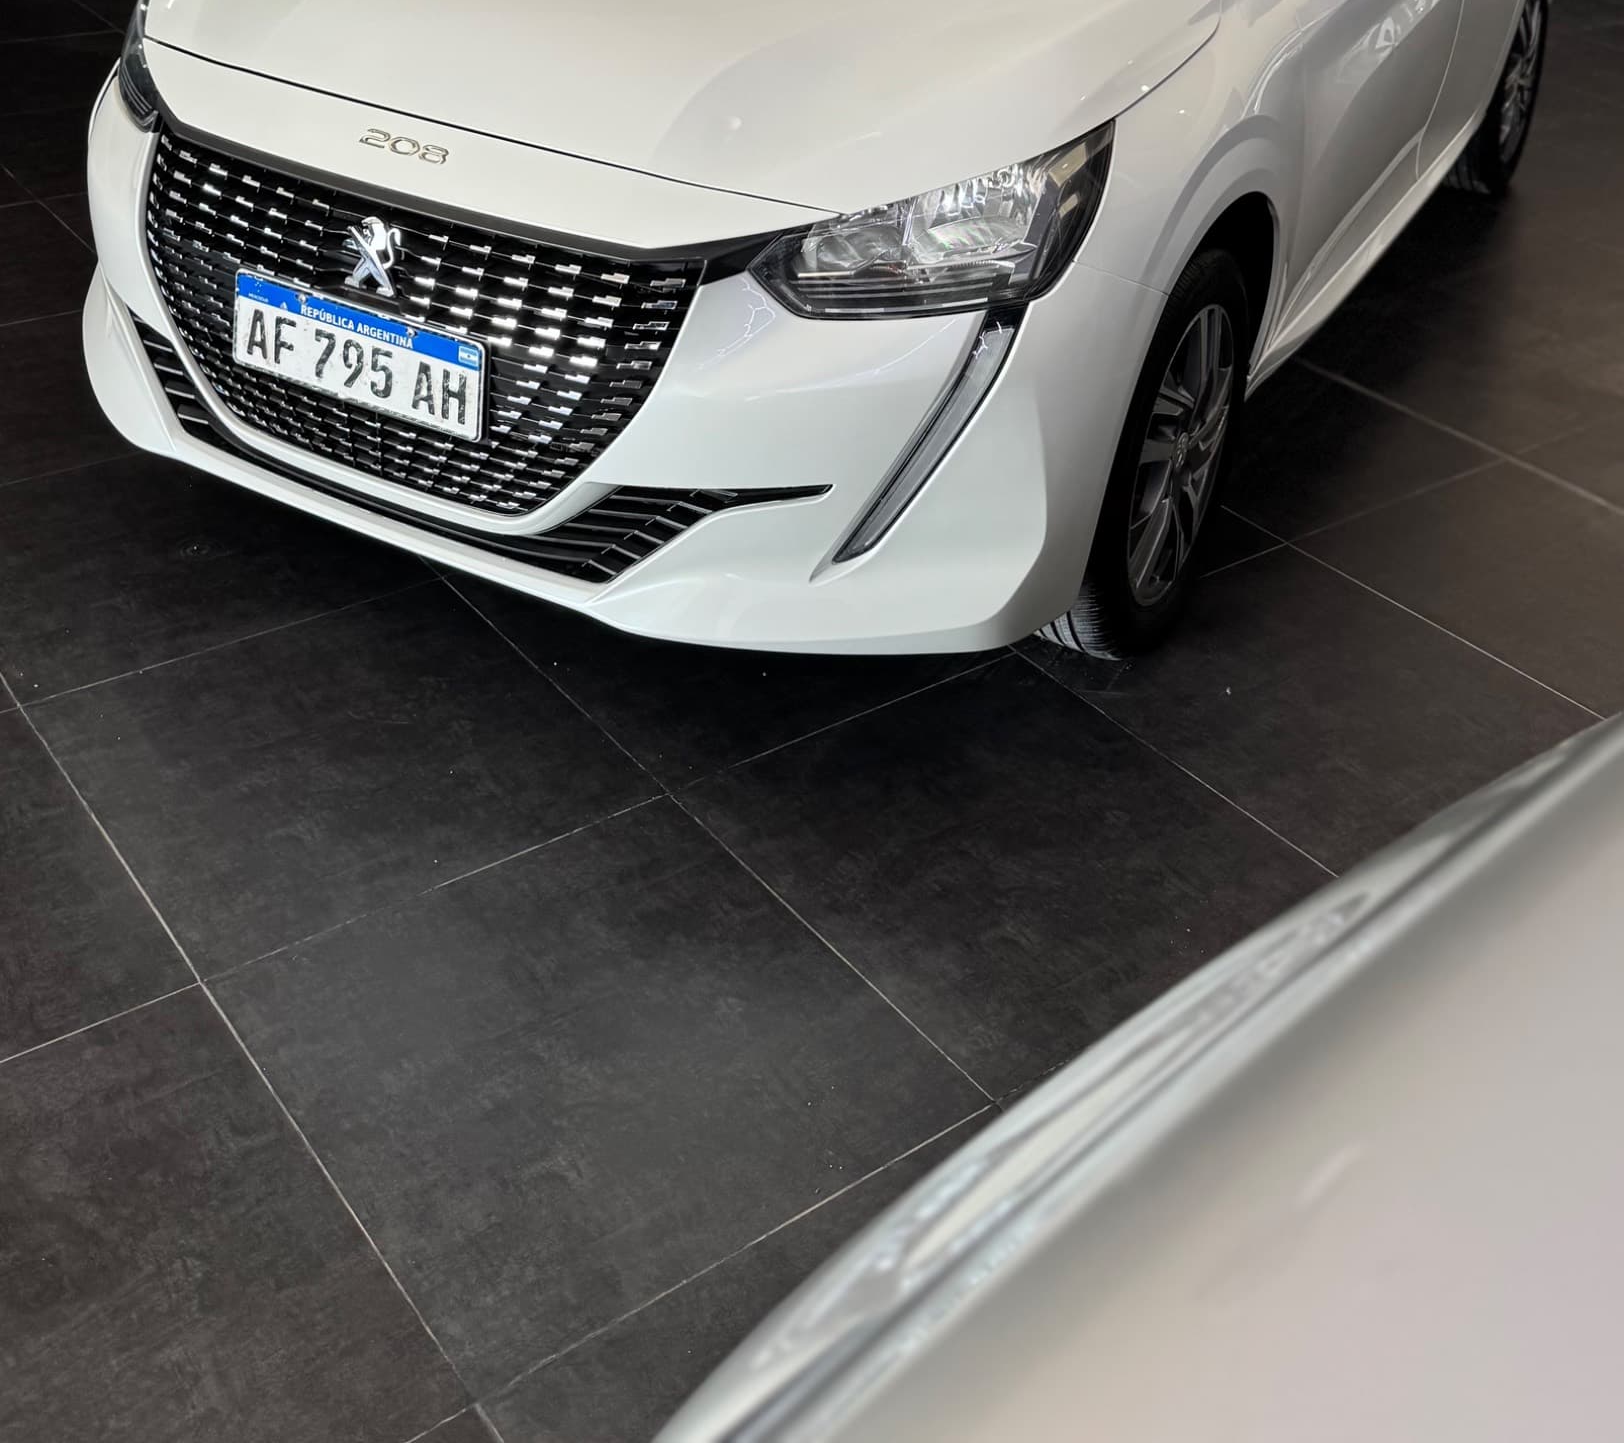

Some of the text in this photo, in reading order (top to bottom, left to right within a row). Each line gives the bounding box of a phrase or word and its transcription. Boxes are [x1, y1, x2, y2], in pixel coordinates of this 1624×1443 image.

[359, 128, 449, 164] 208
[300, 303, 414, 349] REPÚBLICA ARGENTINA
[246, 309, 467, 425] AF 795 AH
